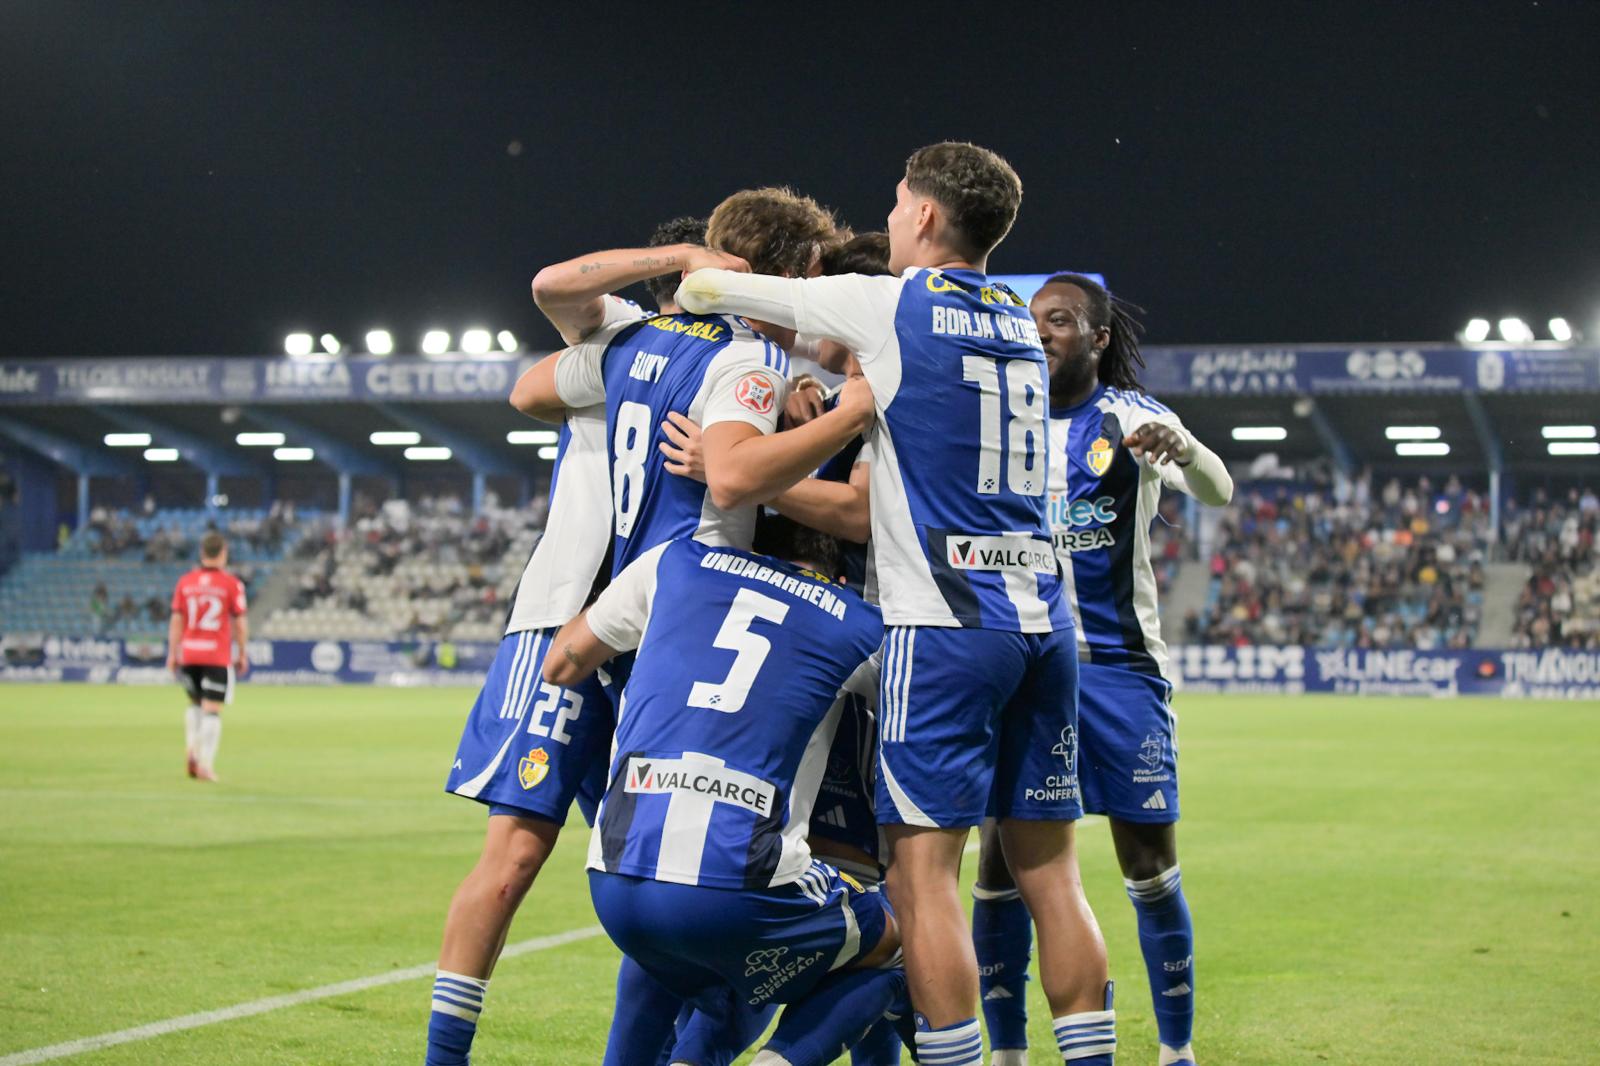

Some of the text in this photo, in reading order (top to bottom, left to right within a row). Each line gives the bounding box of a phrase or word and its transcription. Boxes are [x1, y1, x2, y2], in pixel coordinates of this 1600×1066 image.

[932, 305, 995, 339] BORJA
[366, 363, 508, 395] CETECO
[962, 355, 1046, 497] 18
[614, 401, 651, 539] 8
[1047, 494, 1118, 527] itec
[979, 549, 1056, 571] VALCARC
[700, 551, 848, 622] UNDABARRENA
[186, 595, 223, 632] 12
[686, 587, 791, 714] 5
[526, 681, 585, 746] 22
[657, 771, 768, 811] VALCARCE
[748, 951, 825, 1005] ONFERRADA
